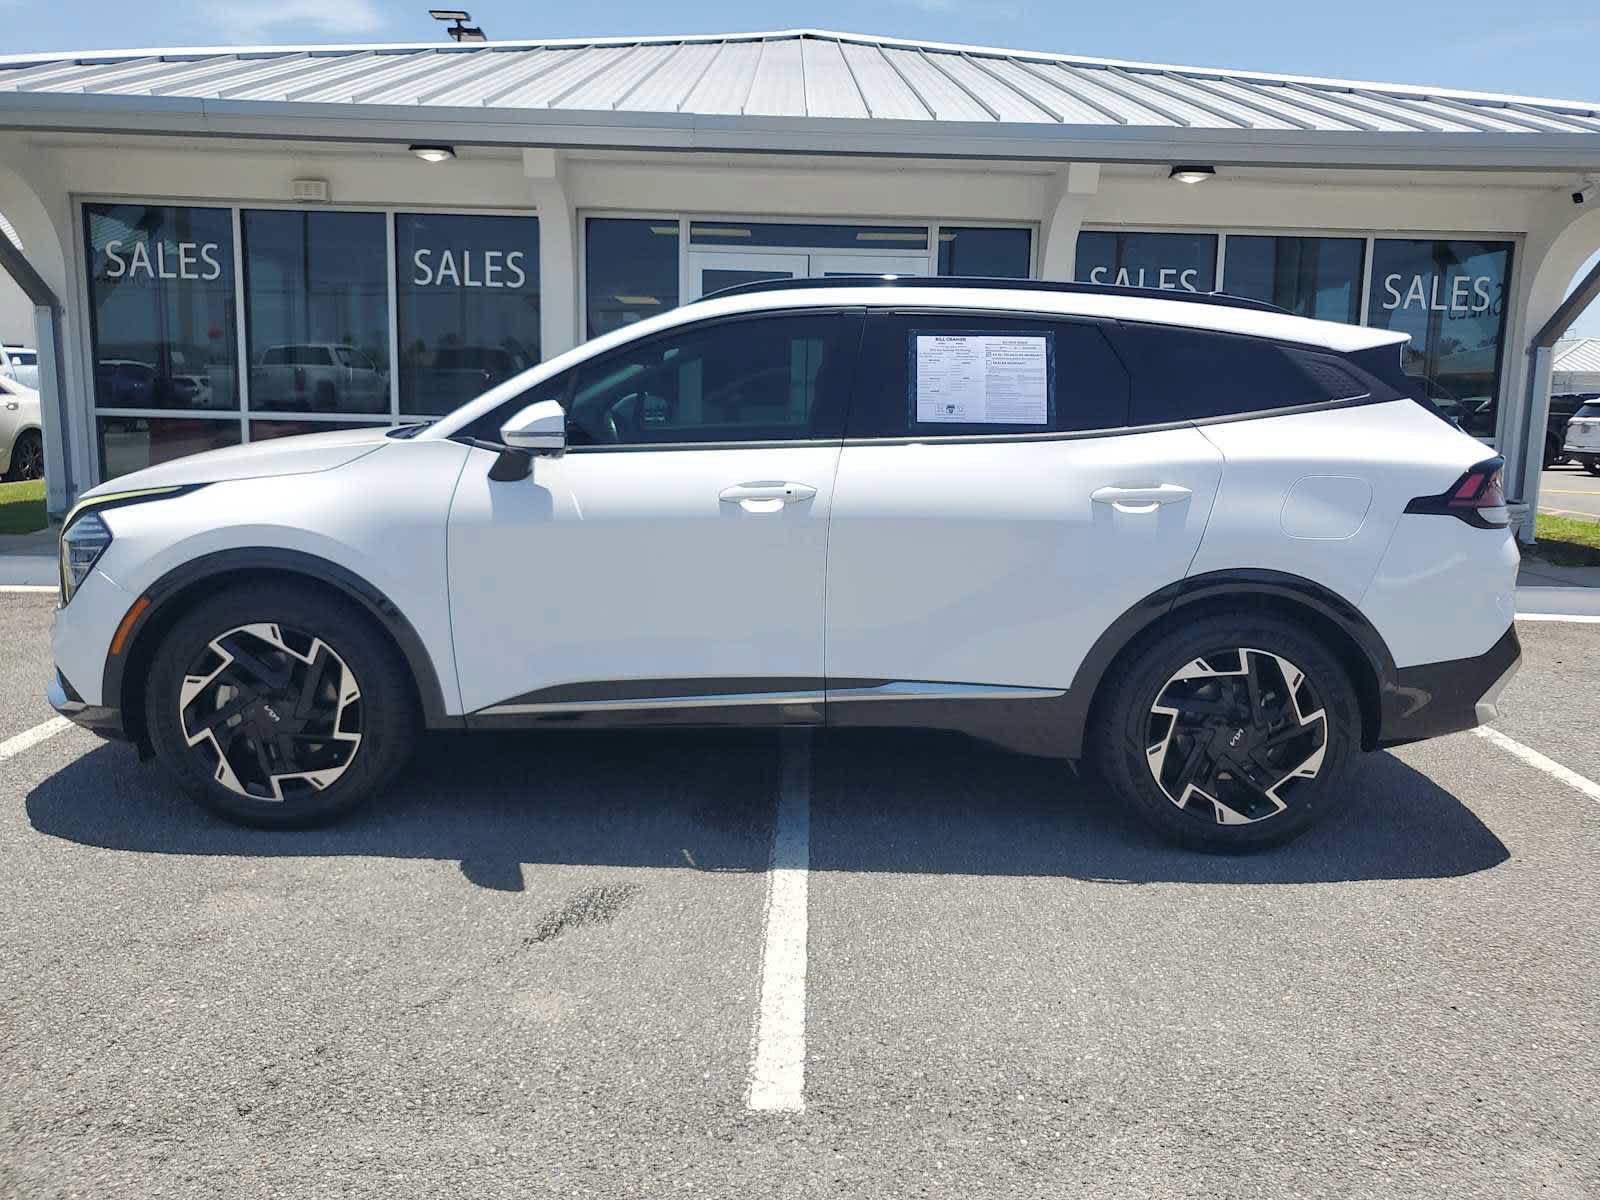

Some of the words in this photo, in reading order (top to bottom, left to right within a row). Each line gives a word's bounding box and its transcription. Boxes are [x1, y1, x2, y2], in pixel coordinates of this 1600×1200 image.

[105, 240, 221, 280] SALES
[414, 248, 526, 288] SALES
[1382, 273, 1491, 312] SALES
